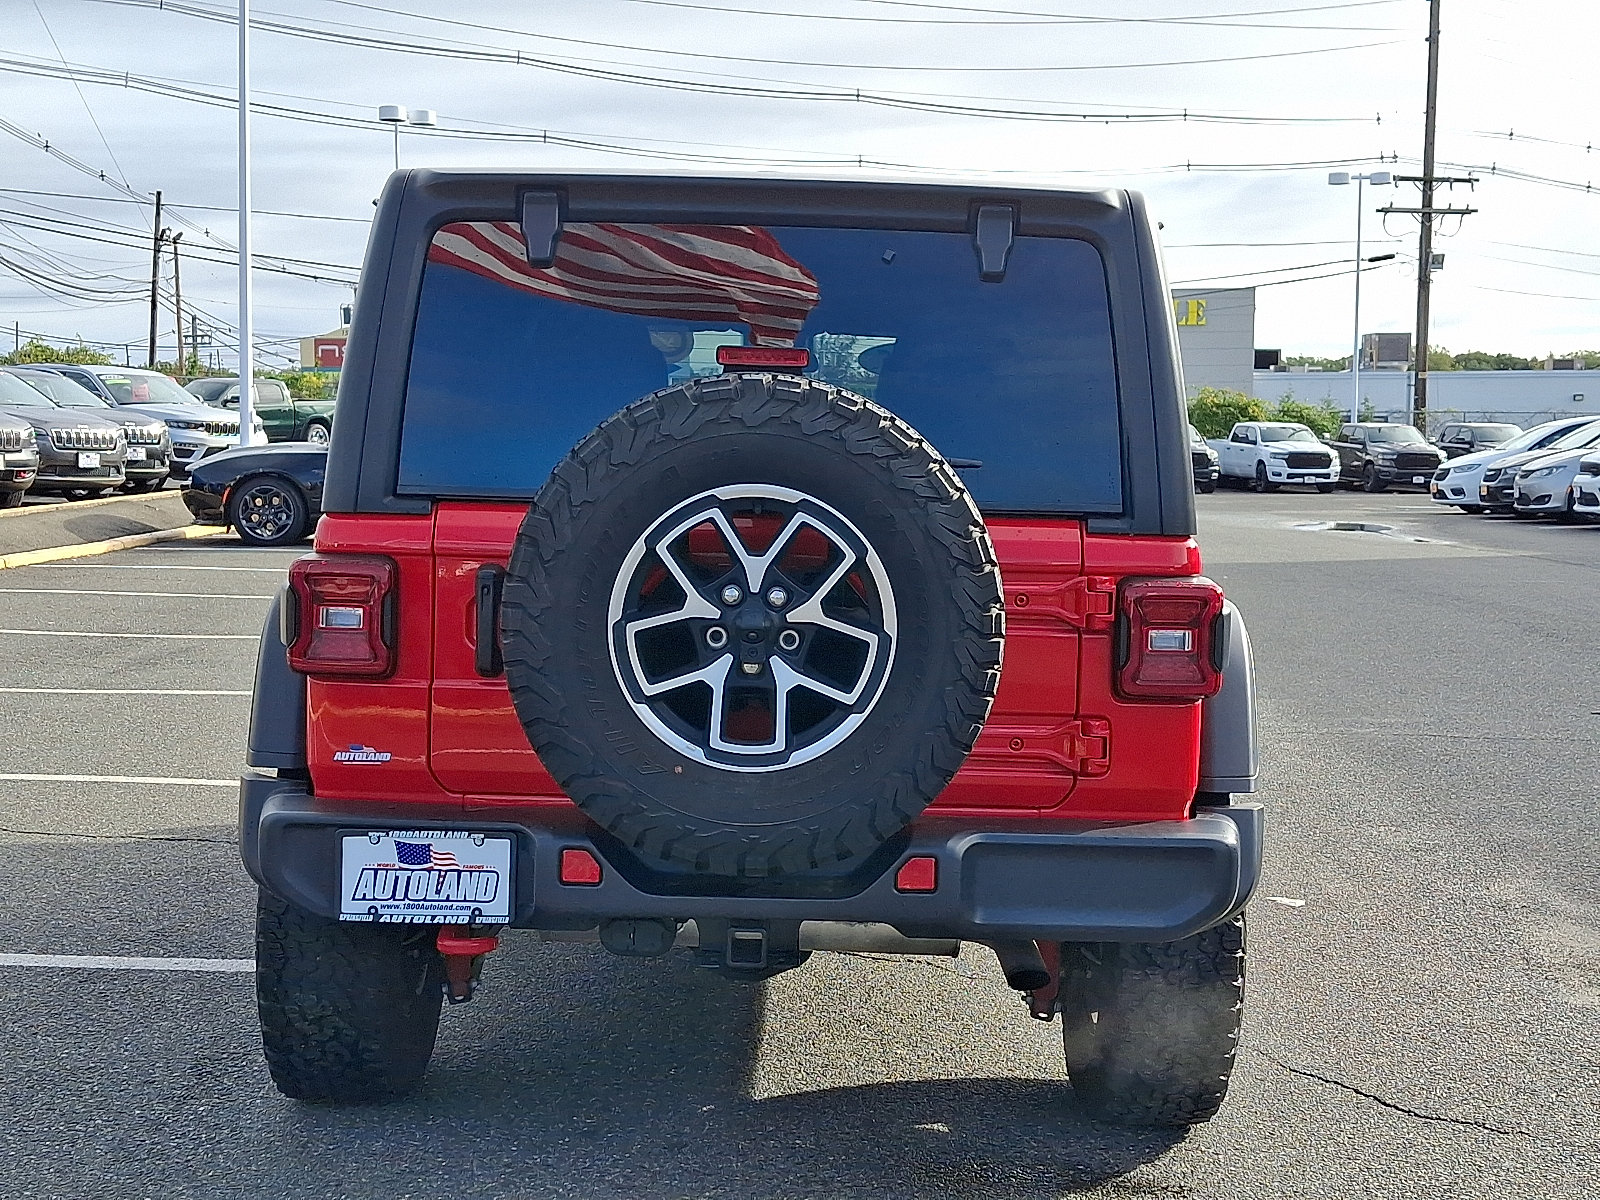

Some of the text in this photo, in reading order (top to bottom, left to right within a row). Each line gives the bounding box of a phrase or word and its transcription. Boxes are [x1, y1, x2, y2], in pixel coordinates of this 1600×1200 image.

[333, 751, 392, 761] AUTOLAND
[462, 863, 485, 871] FAMOUS
[352, 867, 500, 903] AUTOLAND
[380, 901, 472, 912] www.1800Autoland.com
[378, 914, 470, 924] AUTOLAND
